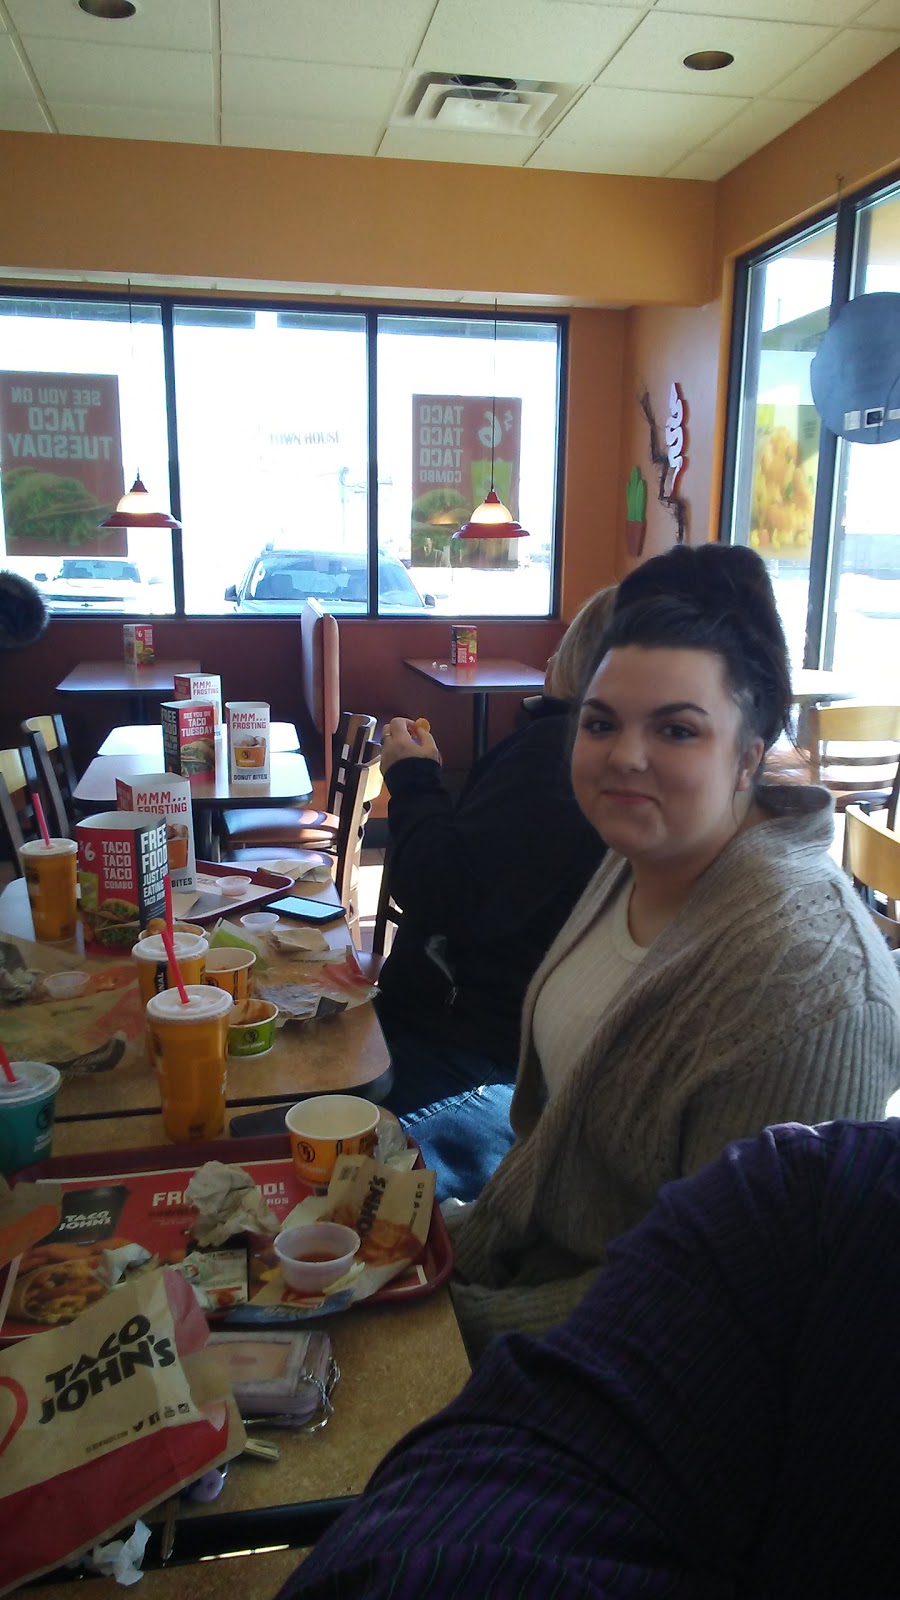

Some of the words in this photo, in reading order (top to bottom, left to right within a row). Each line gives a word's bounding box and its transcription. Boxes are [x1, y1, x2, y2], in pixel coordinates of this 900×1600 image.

[193, 687, 219, 696] FROSTING
[187, 718, 206, 727] TACO
[232, 721, 267, 730] FROSTING
[181, 726, 214, 738] TUESDAY
[233, 773, 252, 781] DONUT
[141, 823, 167, 854] FREE
[102, 841, 130, 854] TACO
[103, 855, 132, 867] TACO
[142, 844, 168, 874] FOOD
[103, 868, 132, 880] TACO
[143, 870, 159, 887] JUST
[104, 881, 133, 890] COMBO
[171, 877, 193, 888] BITES
[356, 1175, 386, 1237] OHN'S
[65, 1211, 109, 1222] TACO
[45, 1314, 151, 1394] TACO
[38, 1334, 176, 1425] JOHN'S
